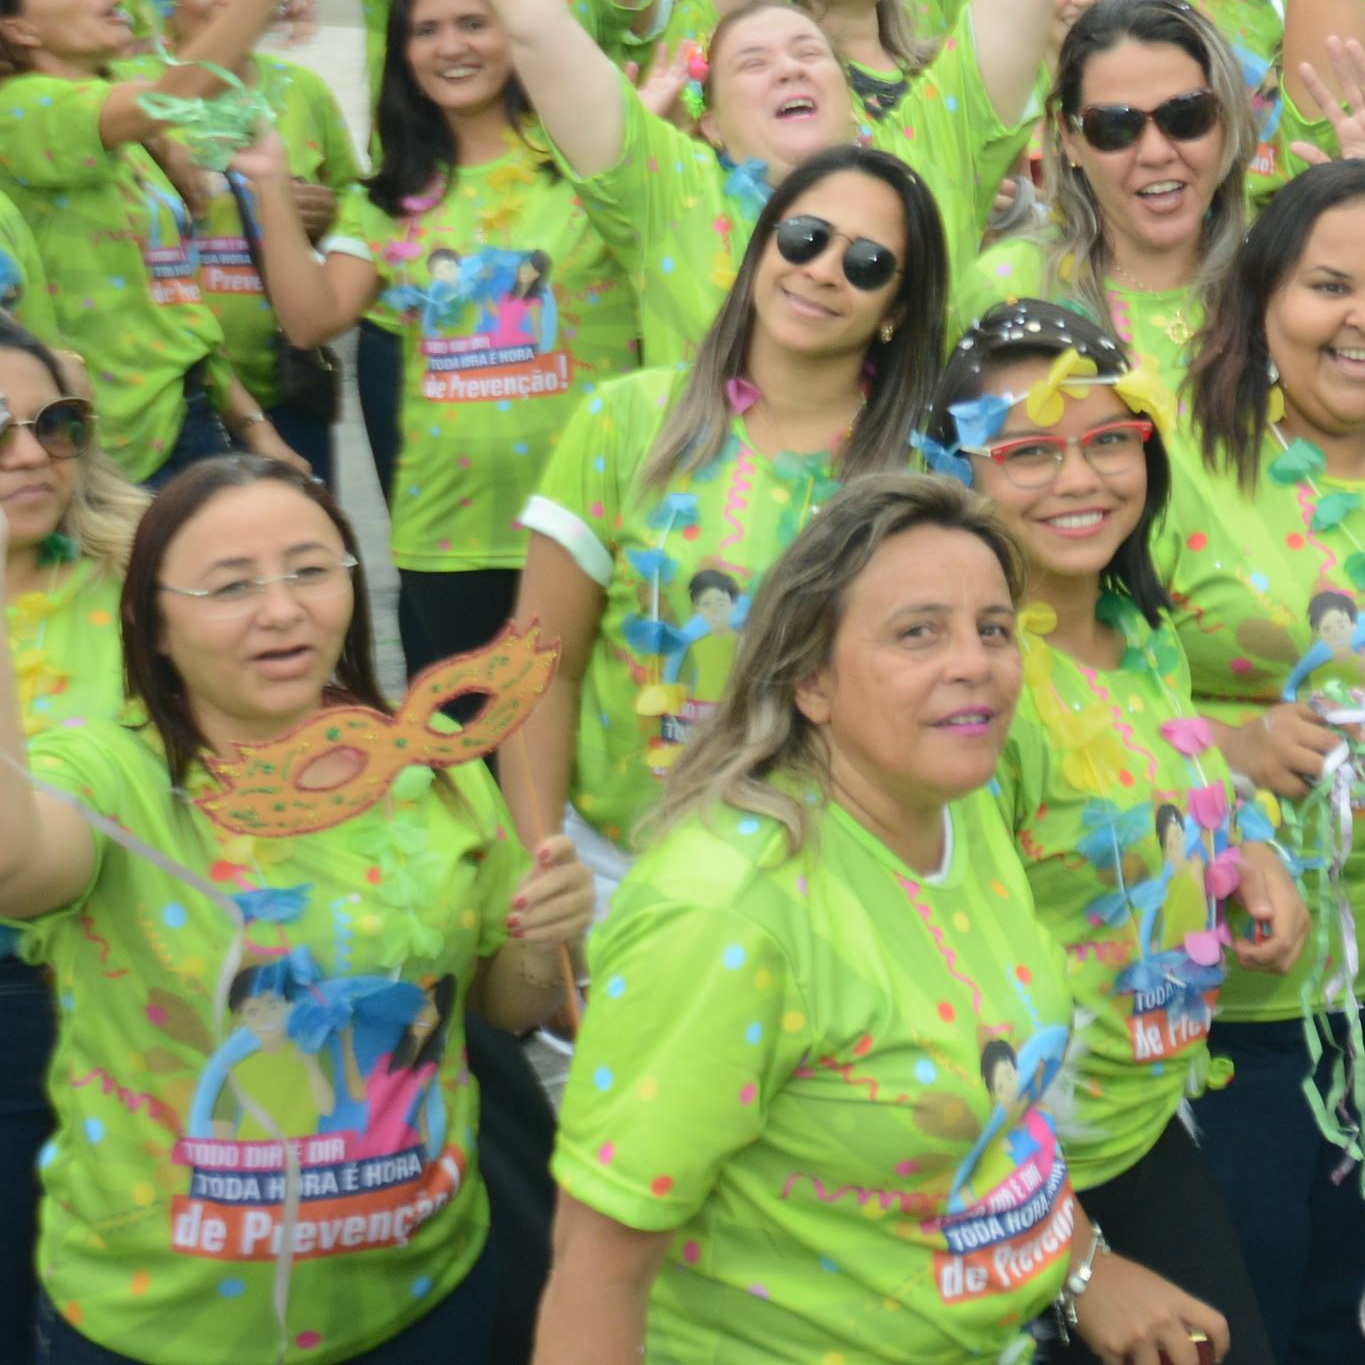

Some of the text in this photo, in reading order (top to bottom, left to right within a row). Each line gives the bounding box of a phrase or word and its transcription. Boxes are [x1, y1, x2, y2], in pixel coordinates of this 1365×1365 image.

[450, 354, 569, 402] Prevenção!
[500, 347, 535, 363] HORA
[183, 1141, 240, 1168] TODO
[197, 1174, 262, 1201] TODA
[361, 1152, 423, 1188] HORA
[175, 1202, 228, 1253] de
[946, 1214, 1006, 1252] TODA
[1006, 1191, 1049, 1234] HORA
[941, 1255, 988, 1299] de
